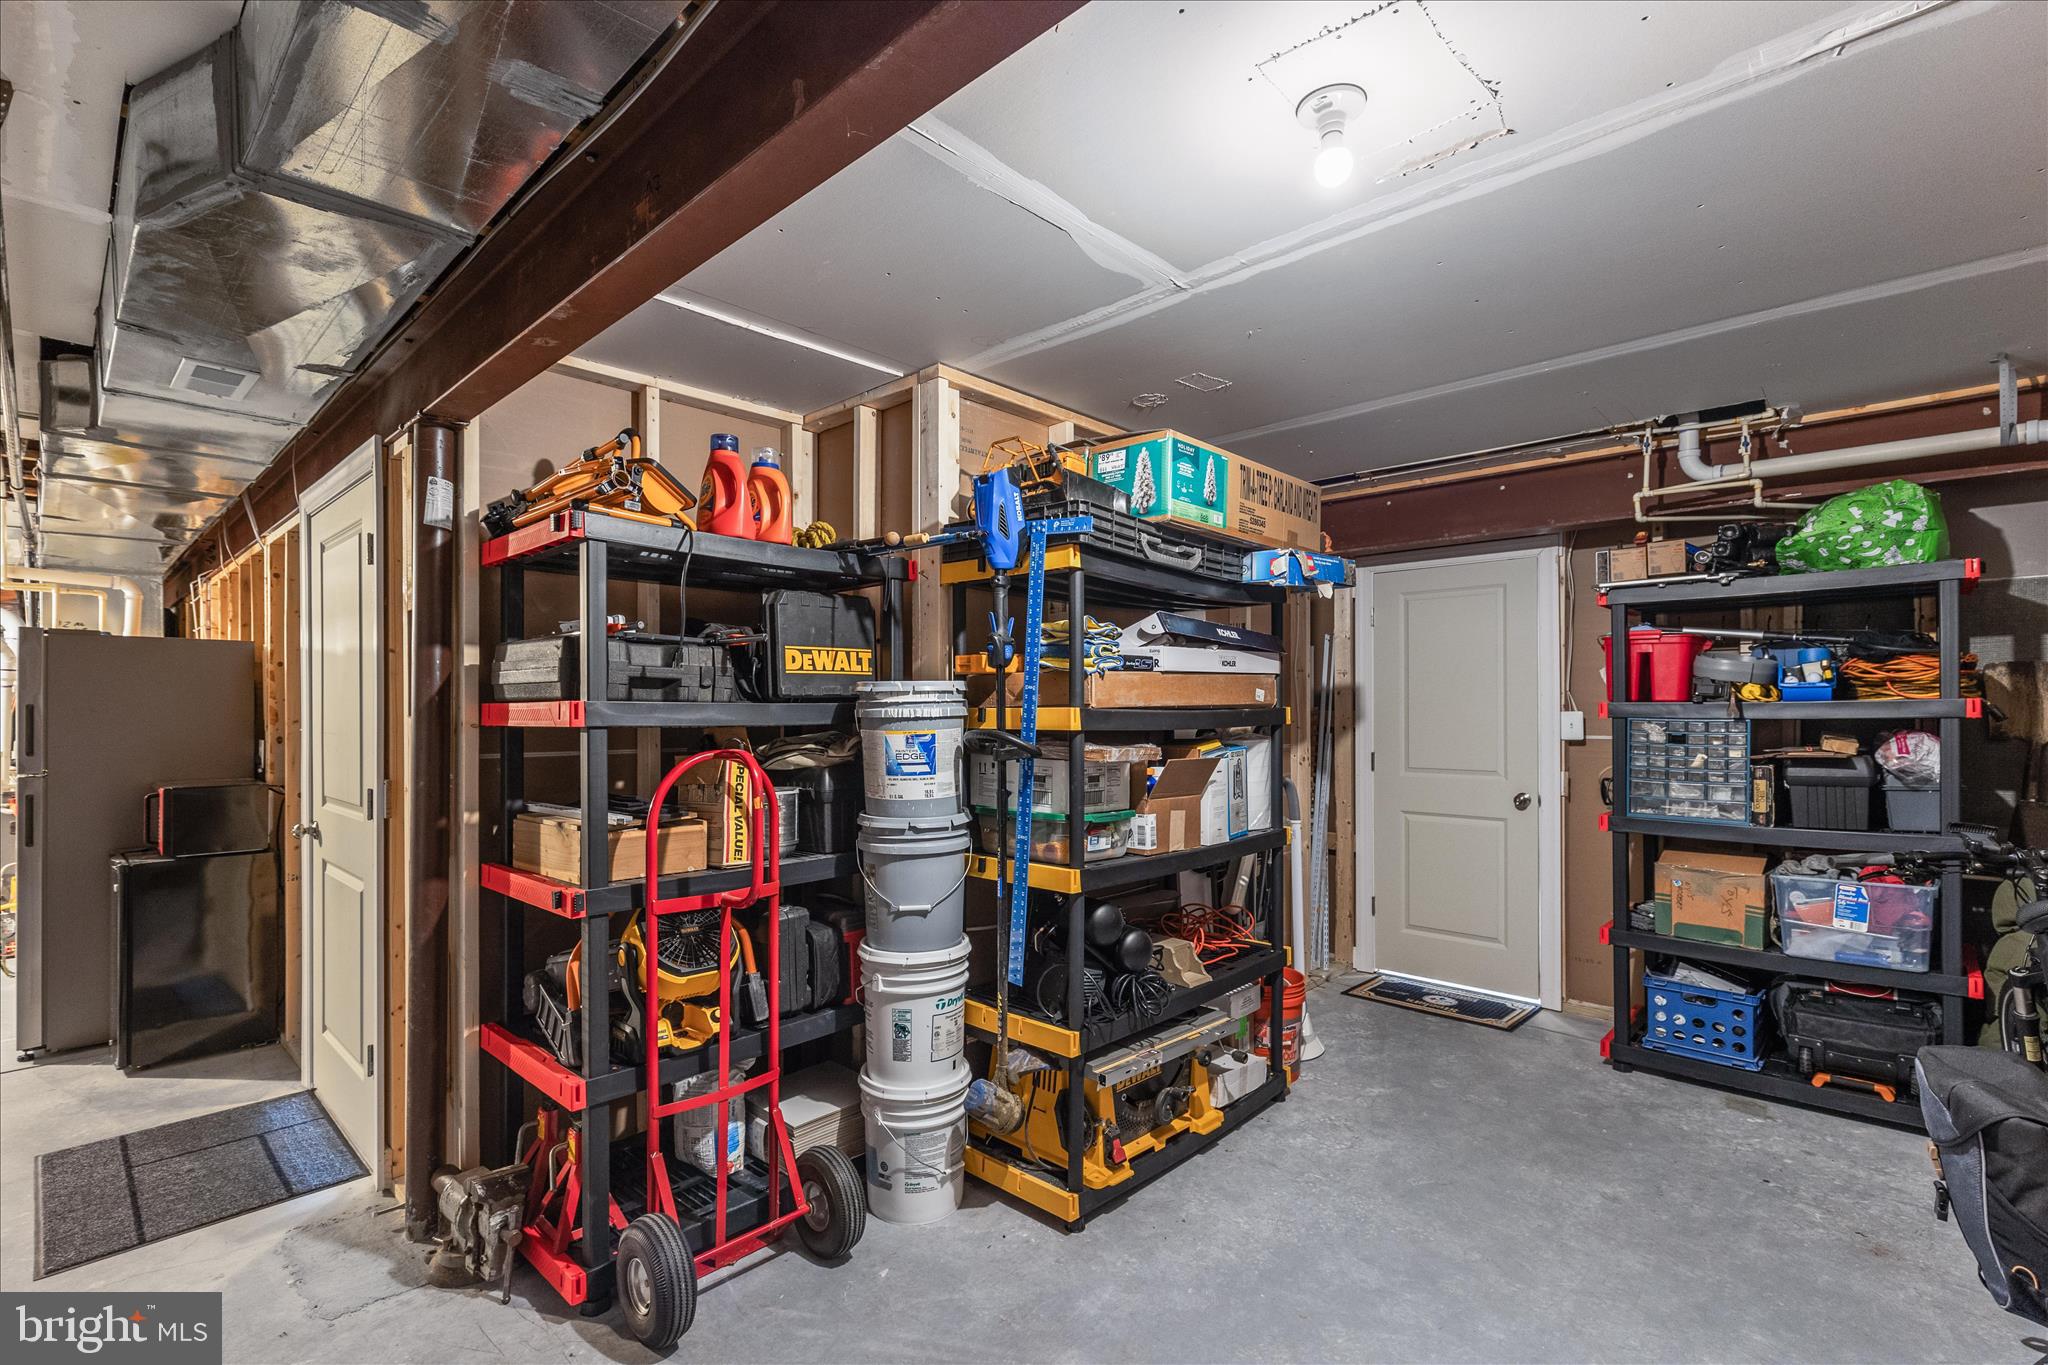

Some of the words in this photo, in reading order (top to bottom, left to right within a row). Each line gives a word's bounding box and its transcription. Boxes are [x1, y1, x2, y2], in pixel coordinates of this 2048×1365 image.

[1013, 491, 1023, 521] KOBALT
[1216, 627, 1241, 640] KOHLER
[785, 650, 873, 672] DEWALT
[1222, 660, 1236, 668] KOHLER
[735, 764, 746, 813] PECIAL
[734, 814, 744, 861] VALUE!
